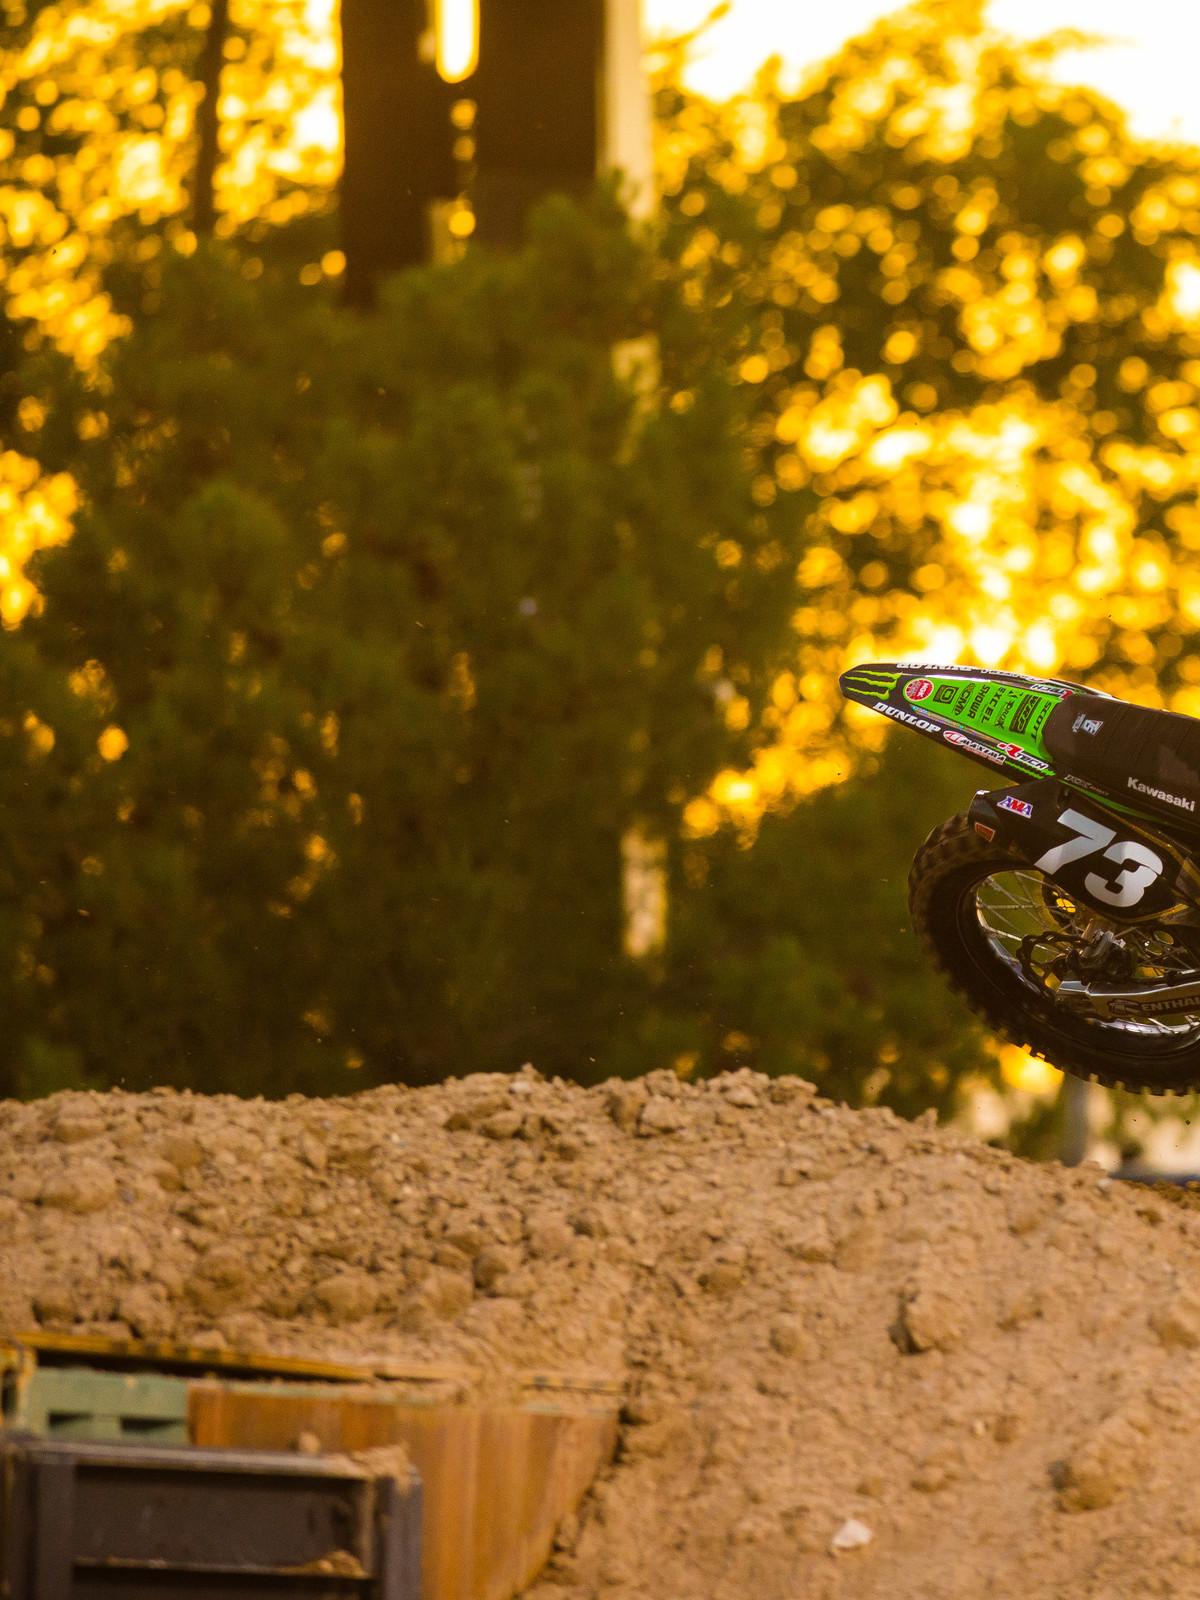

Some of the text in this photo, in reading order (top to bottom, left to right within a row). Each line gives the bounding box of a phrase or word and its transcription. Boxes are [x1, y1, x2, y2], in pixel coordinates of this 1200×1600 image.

[914, 683, 929, 700] NGK
[967, 685, 991, 719] SHOWA
[981, 687, 1007, 724] EXCEL
[872, 702, 941, 734] DUNLOP
[1031, 701, 1052, 743] SCOTT
[961, 738, 1005, 763] MAXIMA
[997, 796, 1033, 818] AMA
[1127, 776, 1196, 812] Kawasaki
[1034, 808, 1163, 908] 73
